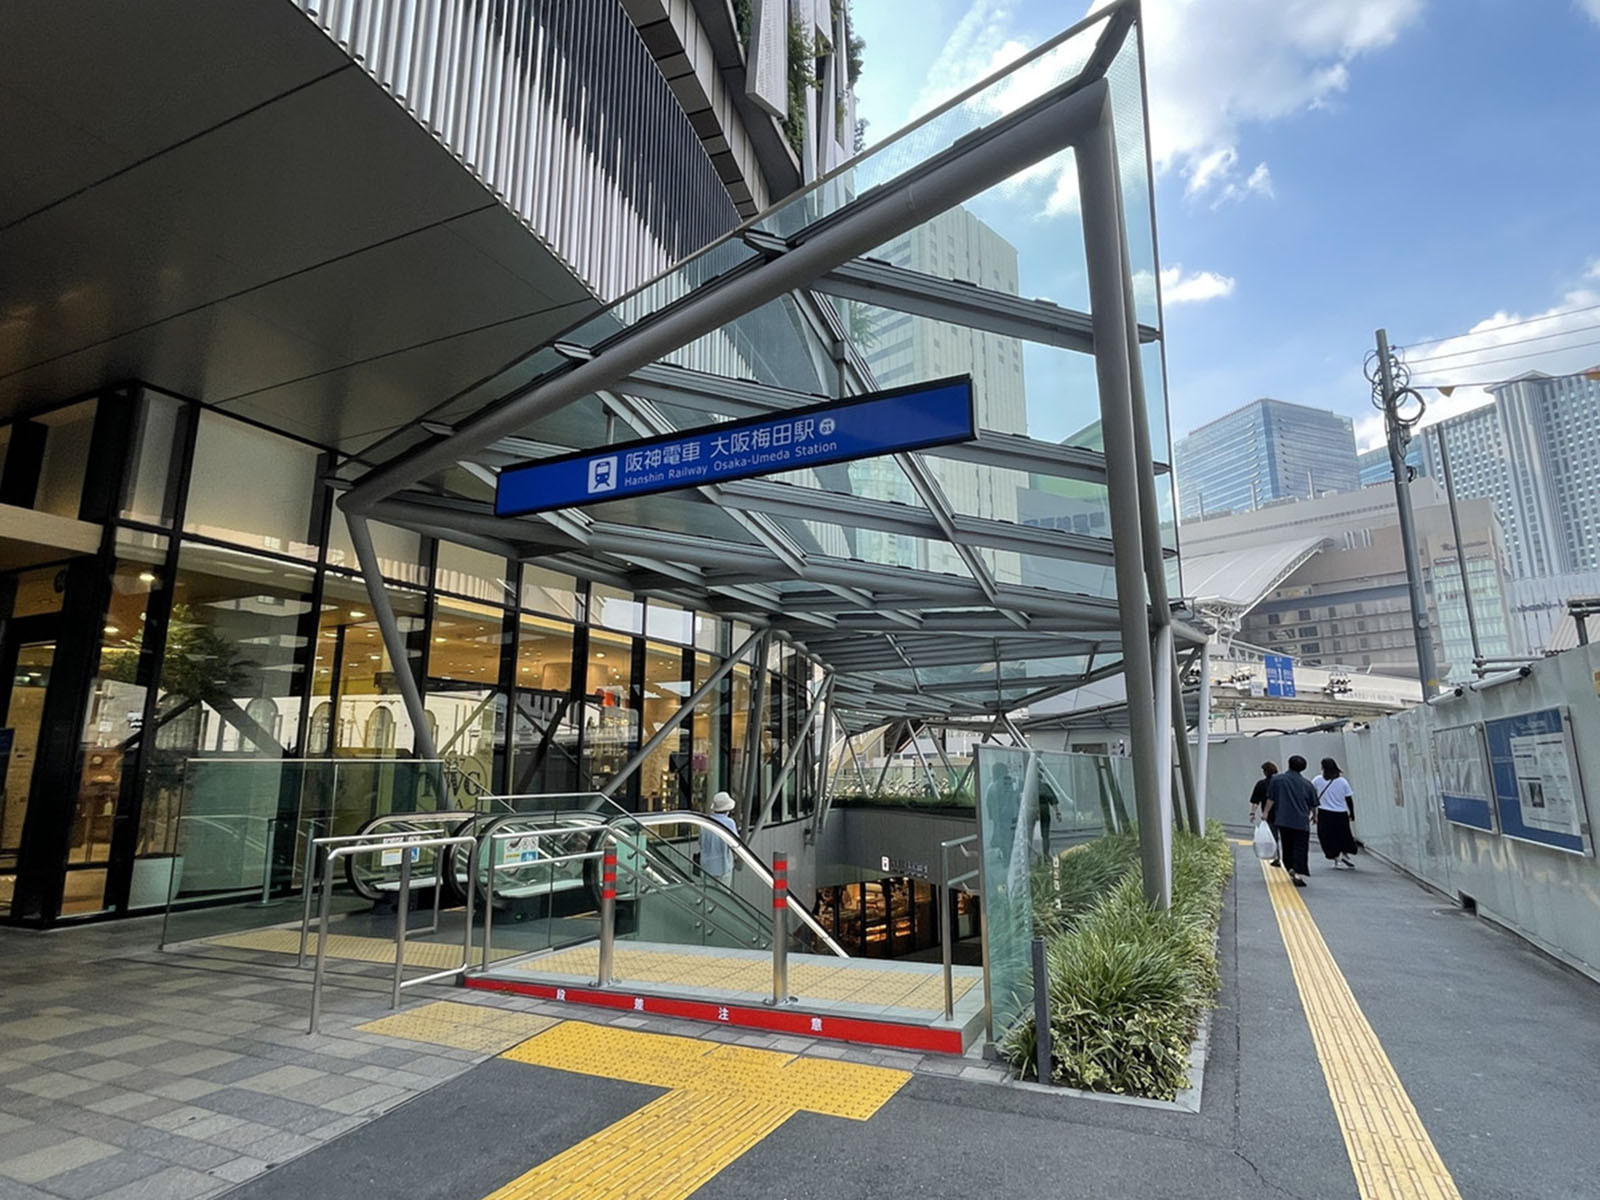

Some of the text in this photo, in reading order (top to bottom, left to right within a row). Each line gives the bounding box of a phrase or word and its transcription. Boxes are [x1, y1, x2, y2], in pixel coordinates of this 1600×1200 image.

[624, 441, 838, 487] Hanshin Railway Osaka-Umeda Station
[625, 419, 815, 473] 阪神電車 大阪梅田駅
